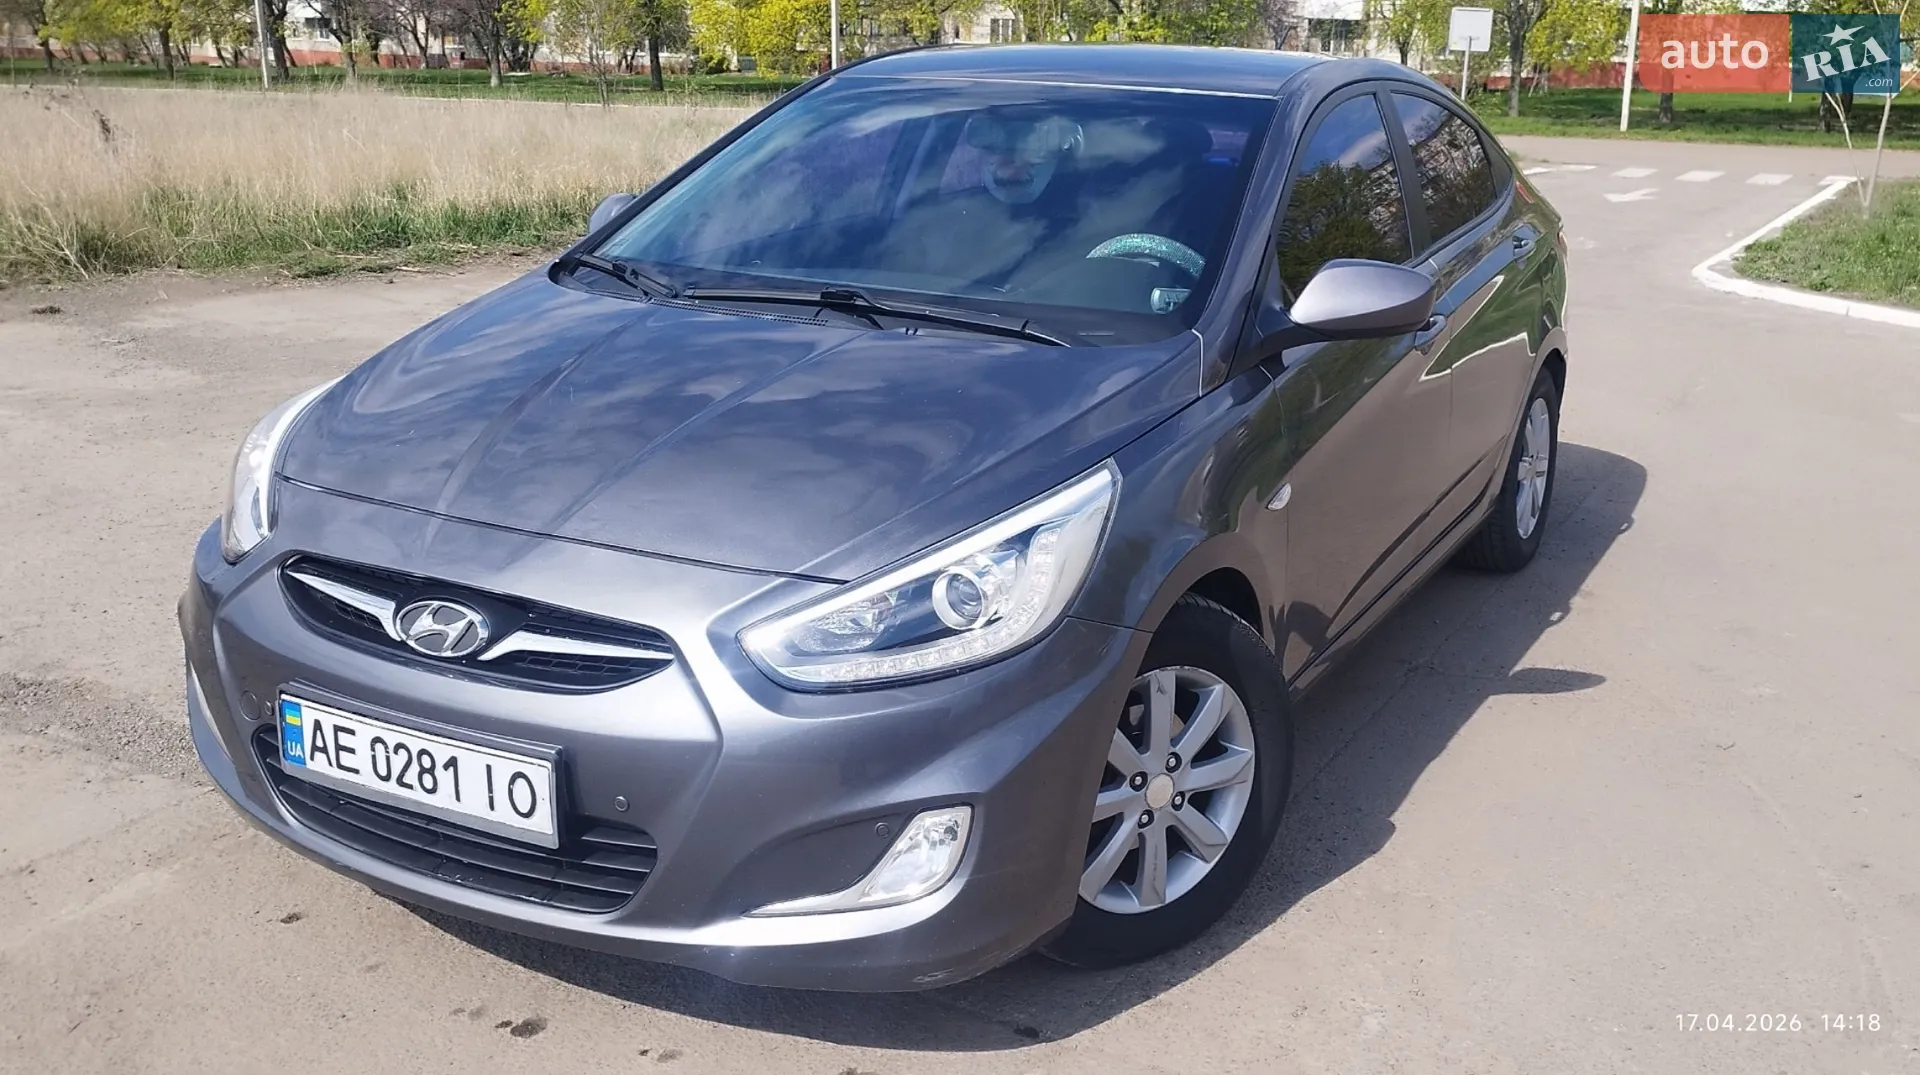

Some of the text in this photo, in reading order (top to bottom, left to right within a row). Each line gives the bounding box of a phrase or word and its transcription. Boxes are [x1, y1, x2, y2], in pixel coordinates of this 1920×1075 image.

[287, 740, 304, 759] UA
[309, 718, 360, 775] AE
[370, 735, 461, 802] 0281
